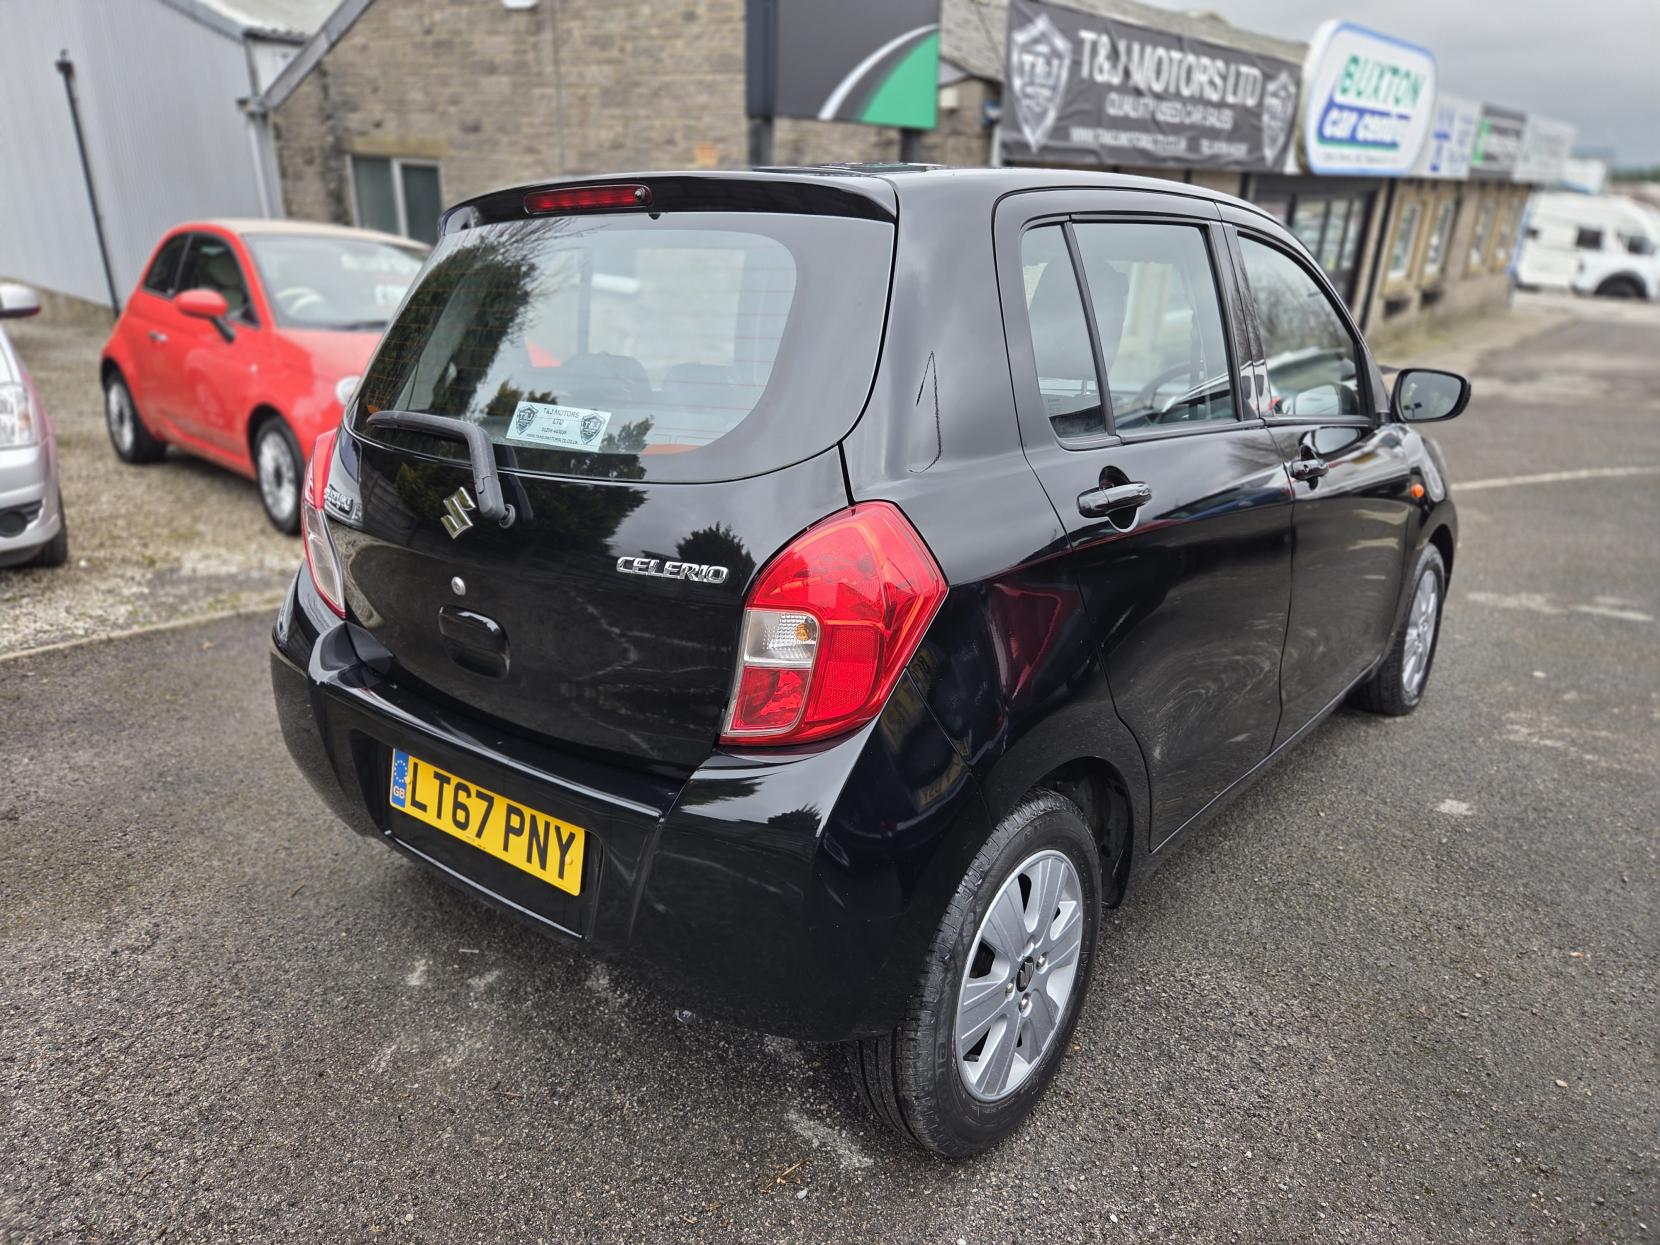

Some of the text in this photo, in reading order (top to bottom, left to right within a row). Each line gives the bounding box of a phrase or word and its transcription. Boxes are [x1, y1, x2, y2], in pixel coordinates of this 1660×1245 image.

[1077, 29, 1263, 108] T&J MOTORS LTD
[1340, 55, 1422, 108] BUXTON
[616, 556, 729, 584] CELERIO
[393, 785, 406, 799] GB
[410, 762, 576, 881] LT67 PNY
